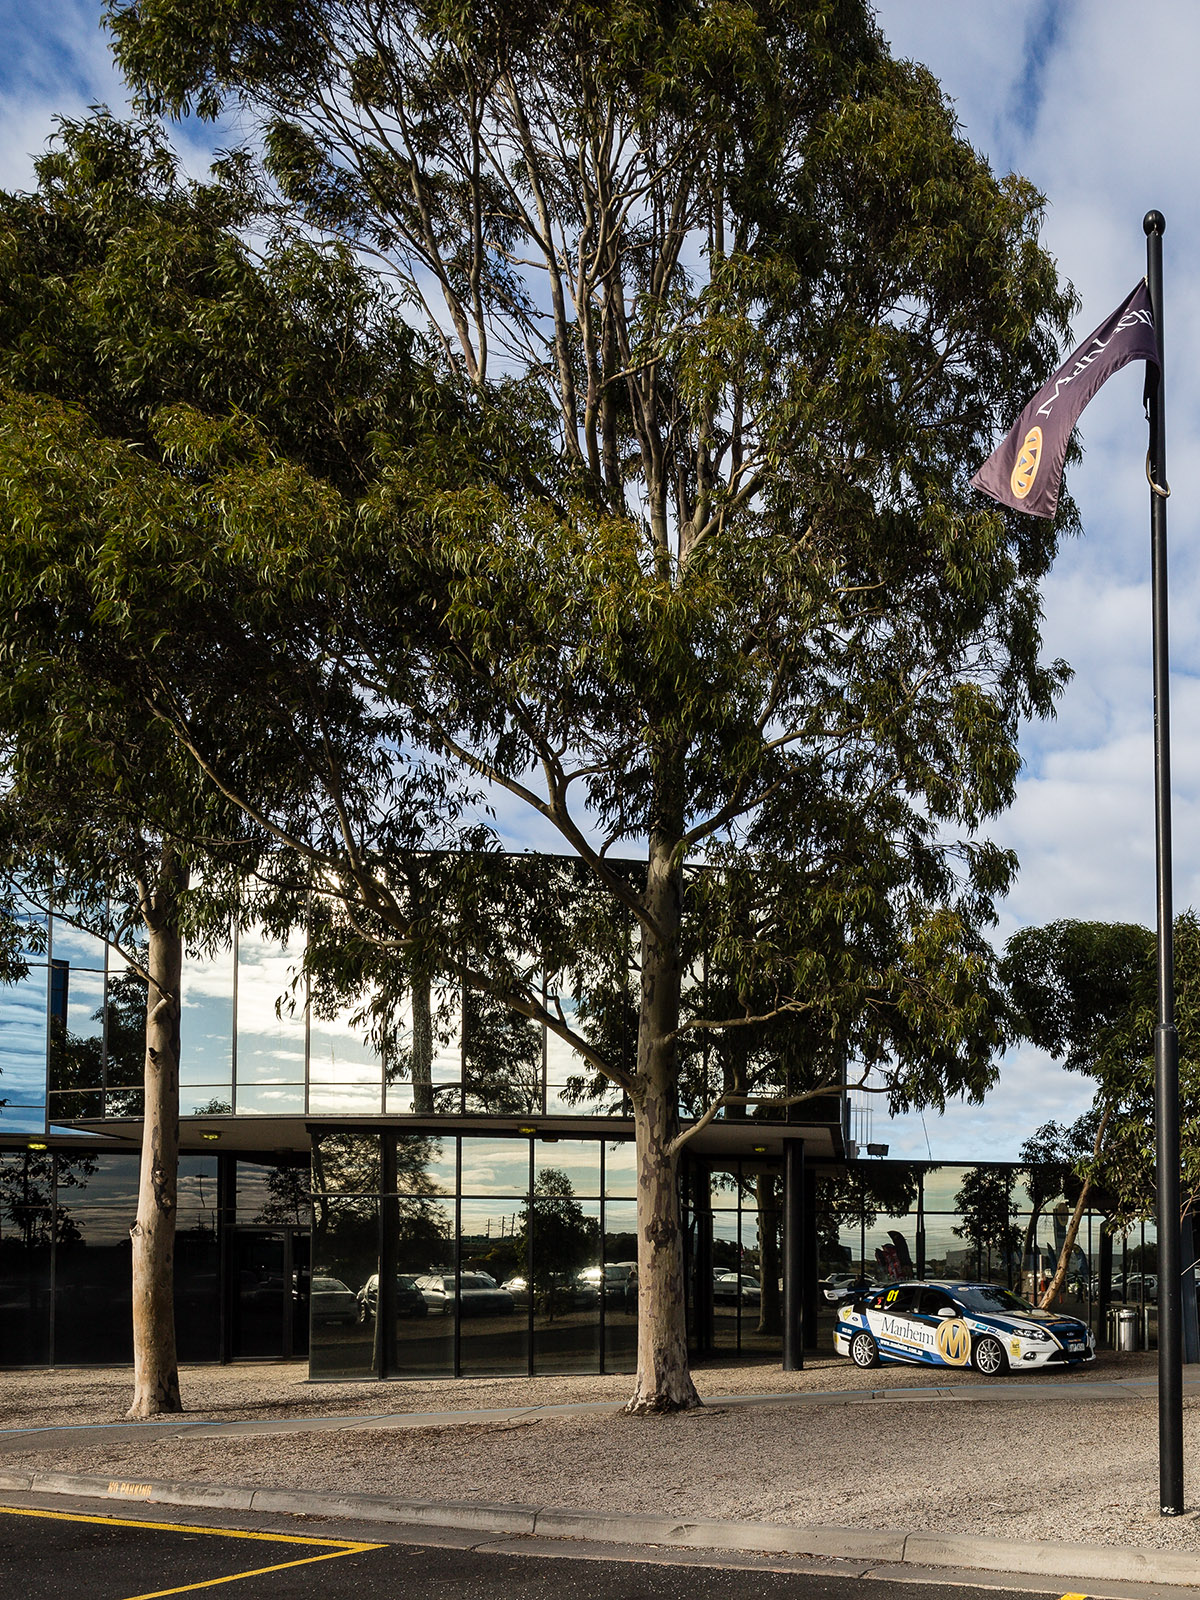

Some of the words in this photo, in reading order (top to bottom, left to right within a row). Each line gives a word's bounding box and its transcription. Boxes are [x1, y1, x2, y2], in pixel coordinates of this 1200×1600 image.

[887, 1290, 899, 1302] 01
[881, 1316, 934, 1345] Manheim
[107, 1481, 119, 1494] NO
[120, 1482, 152, 1496] PARKING
